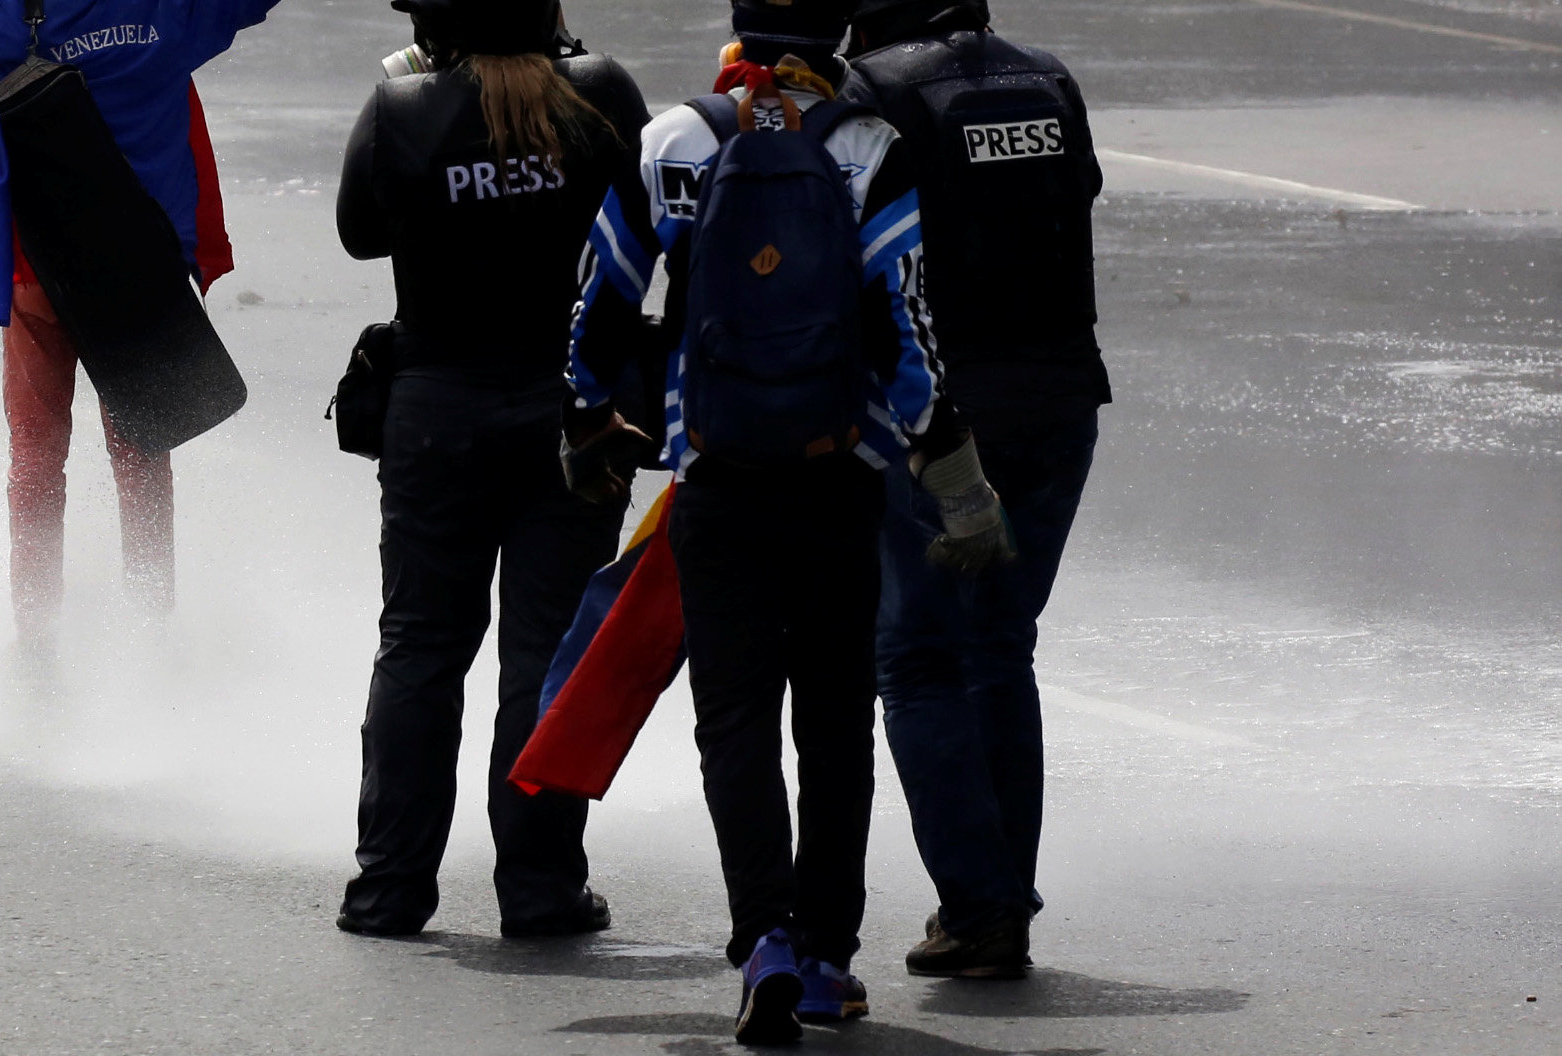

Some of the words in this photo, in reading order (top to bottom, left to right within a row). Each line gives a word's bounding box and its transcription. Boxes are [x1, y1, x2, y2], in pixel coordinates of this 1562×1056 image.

[50, 23, 160, 63] VENEZUELA
[965, 122, 1065, 159] PRESS
[446, 153, 566, 203] PRESS
